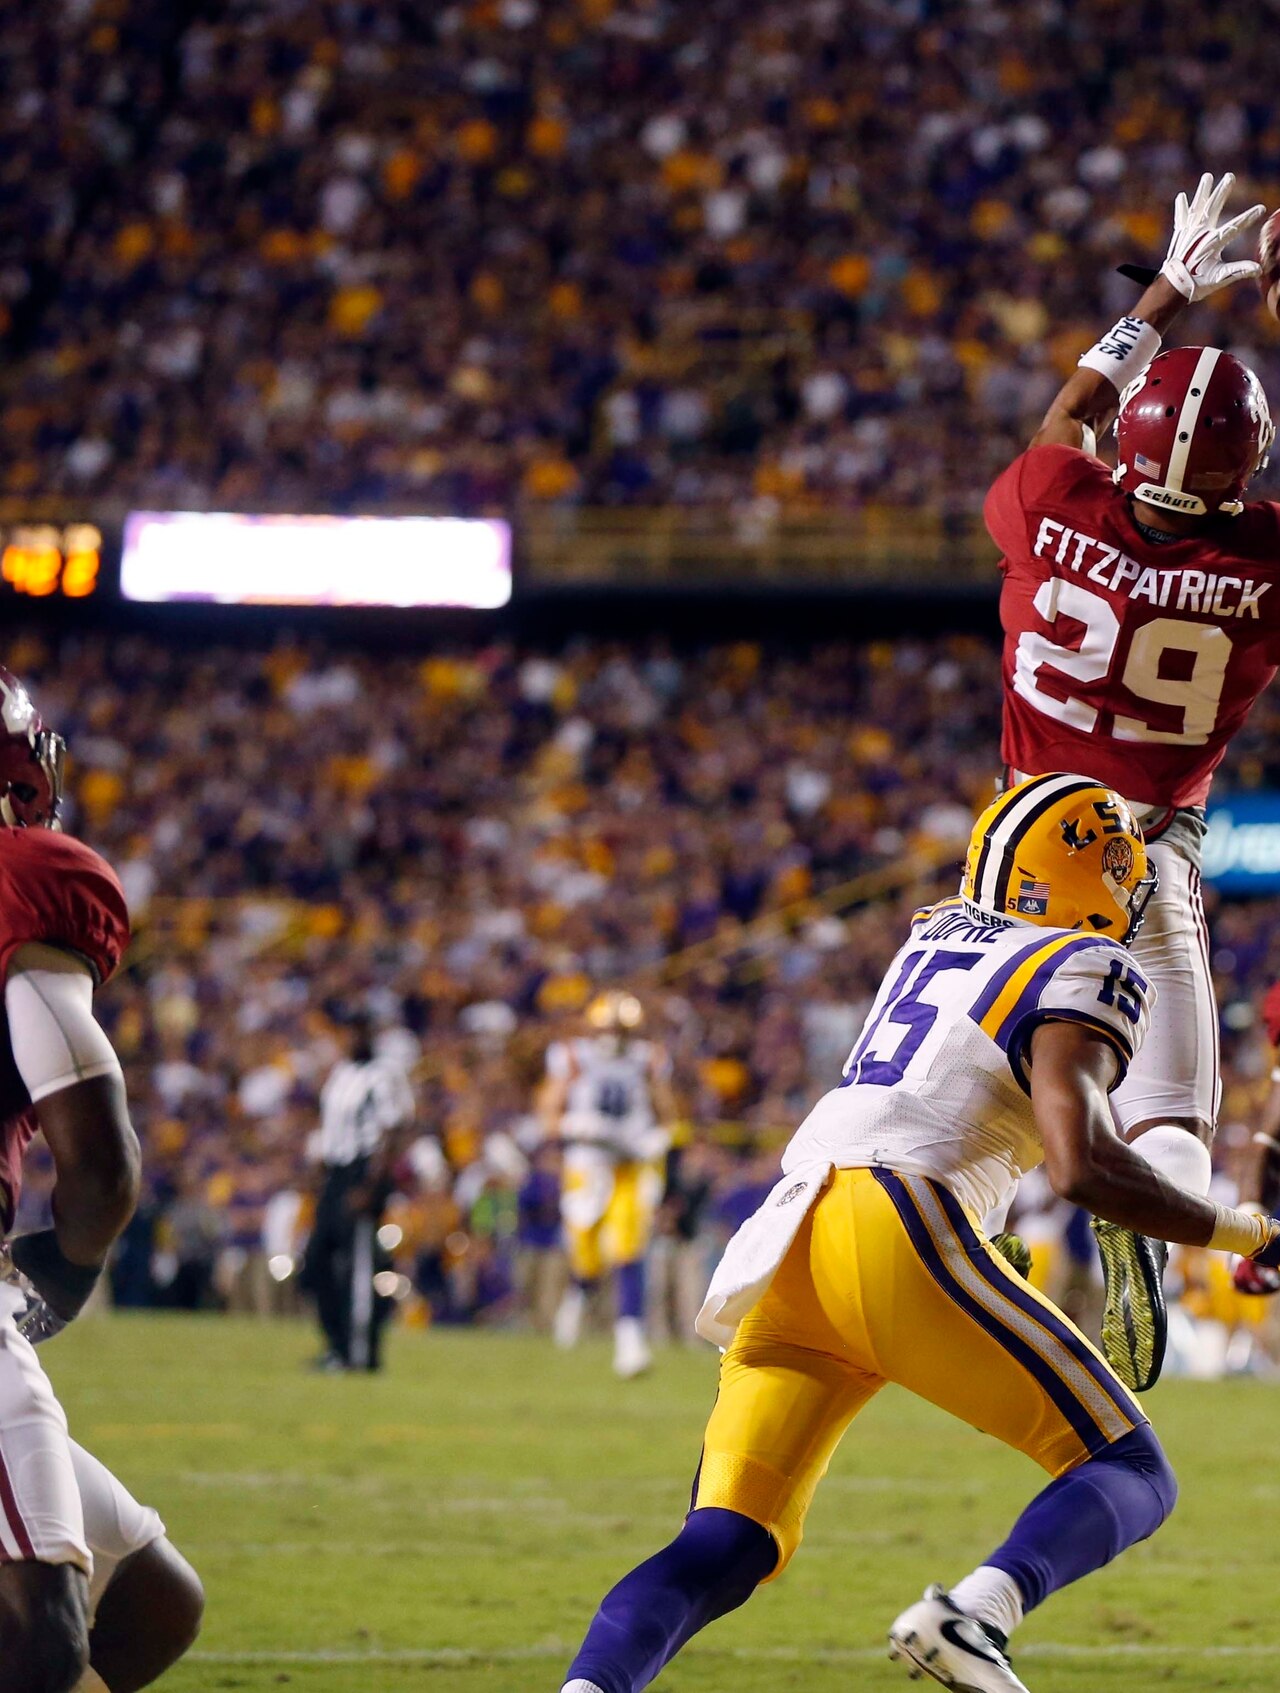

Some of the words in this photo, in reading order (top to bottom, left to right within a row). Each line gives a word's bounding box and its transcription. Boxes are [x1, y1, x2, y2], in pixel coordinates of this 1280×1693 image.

[1142, 489, 1199, 510] schutt
[1033, 516, 1272, 620] FITZPATRICK
[1013, 576, 1233, 746] 29
[838, 949, 985, 1088] 15
[1097, 959, 1148, 1024] 15
